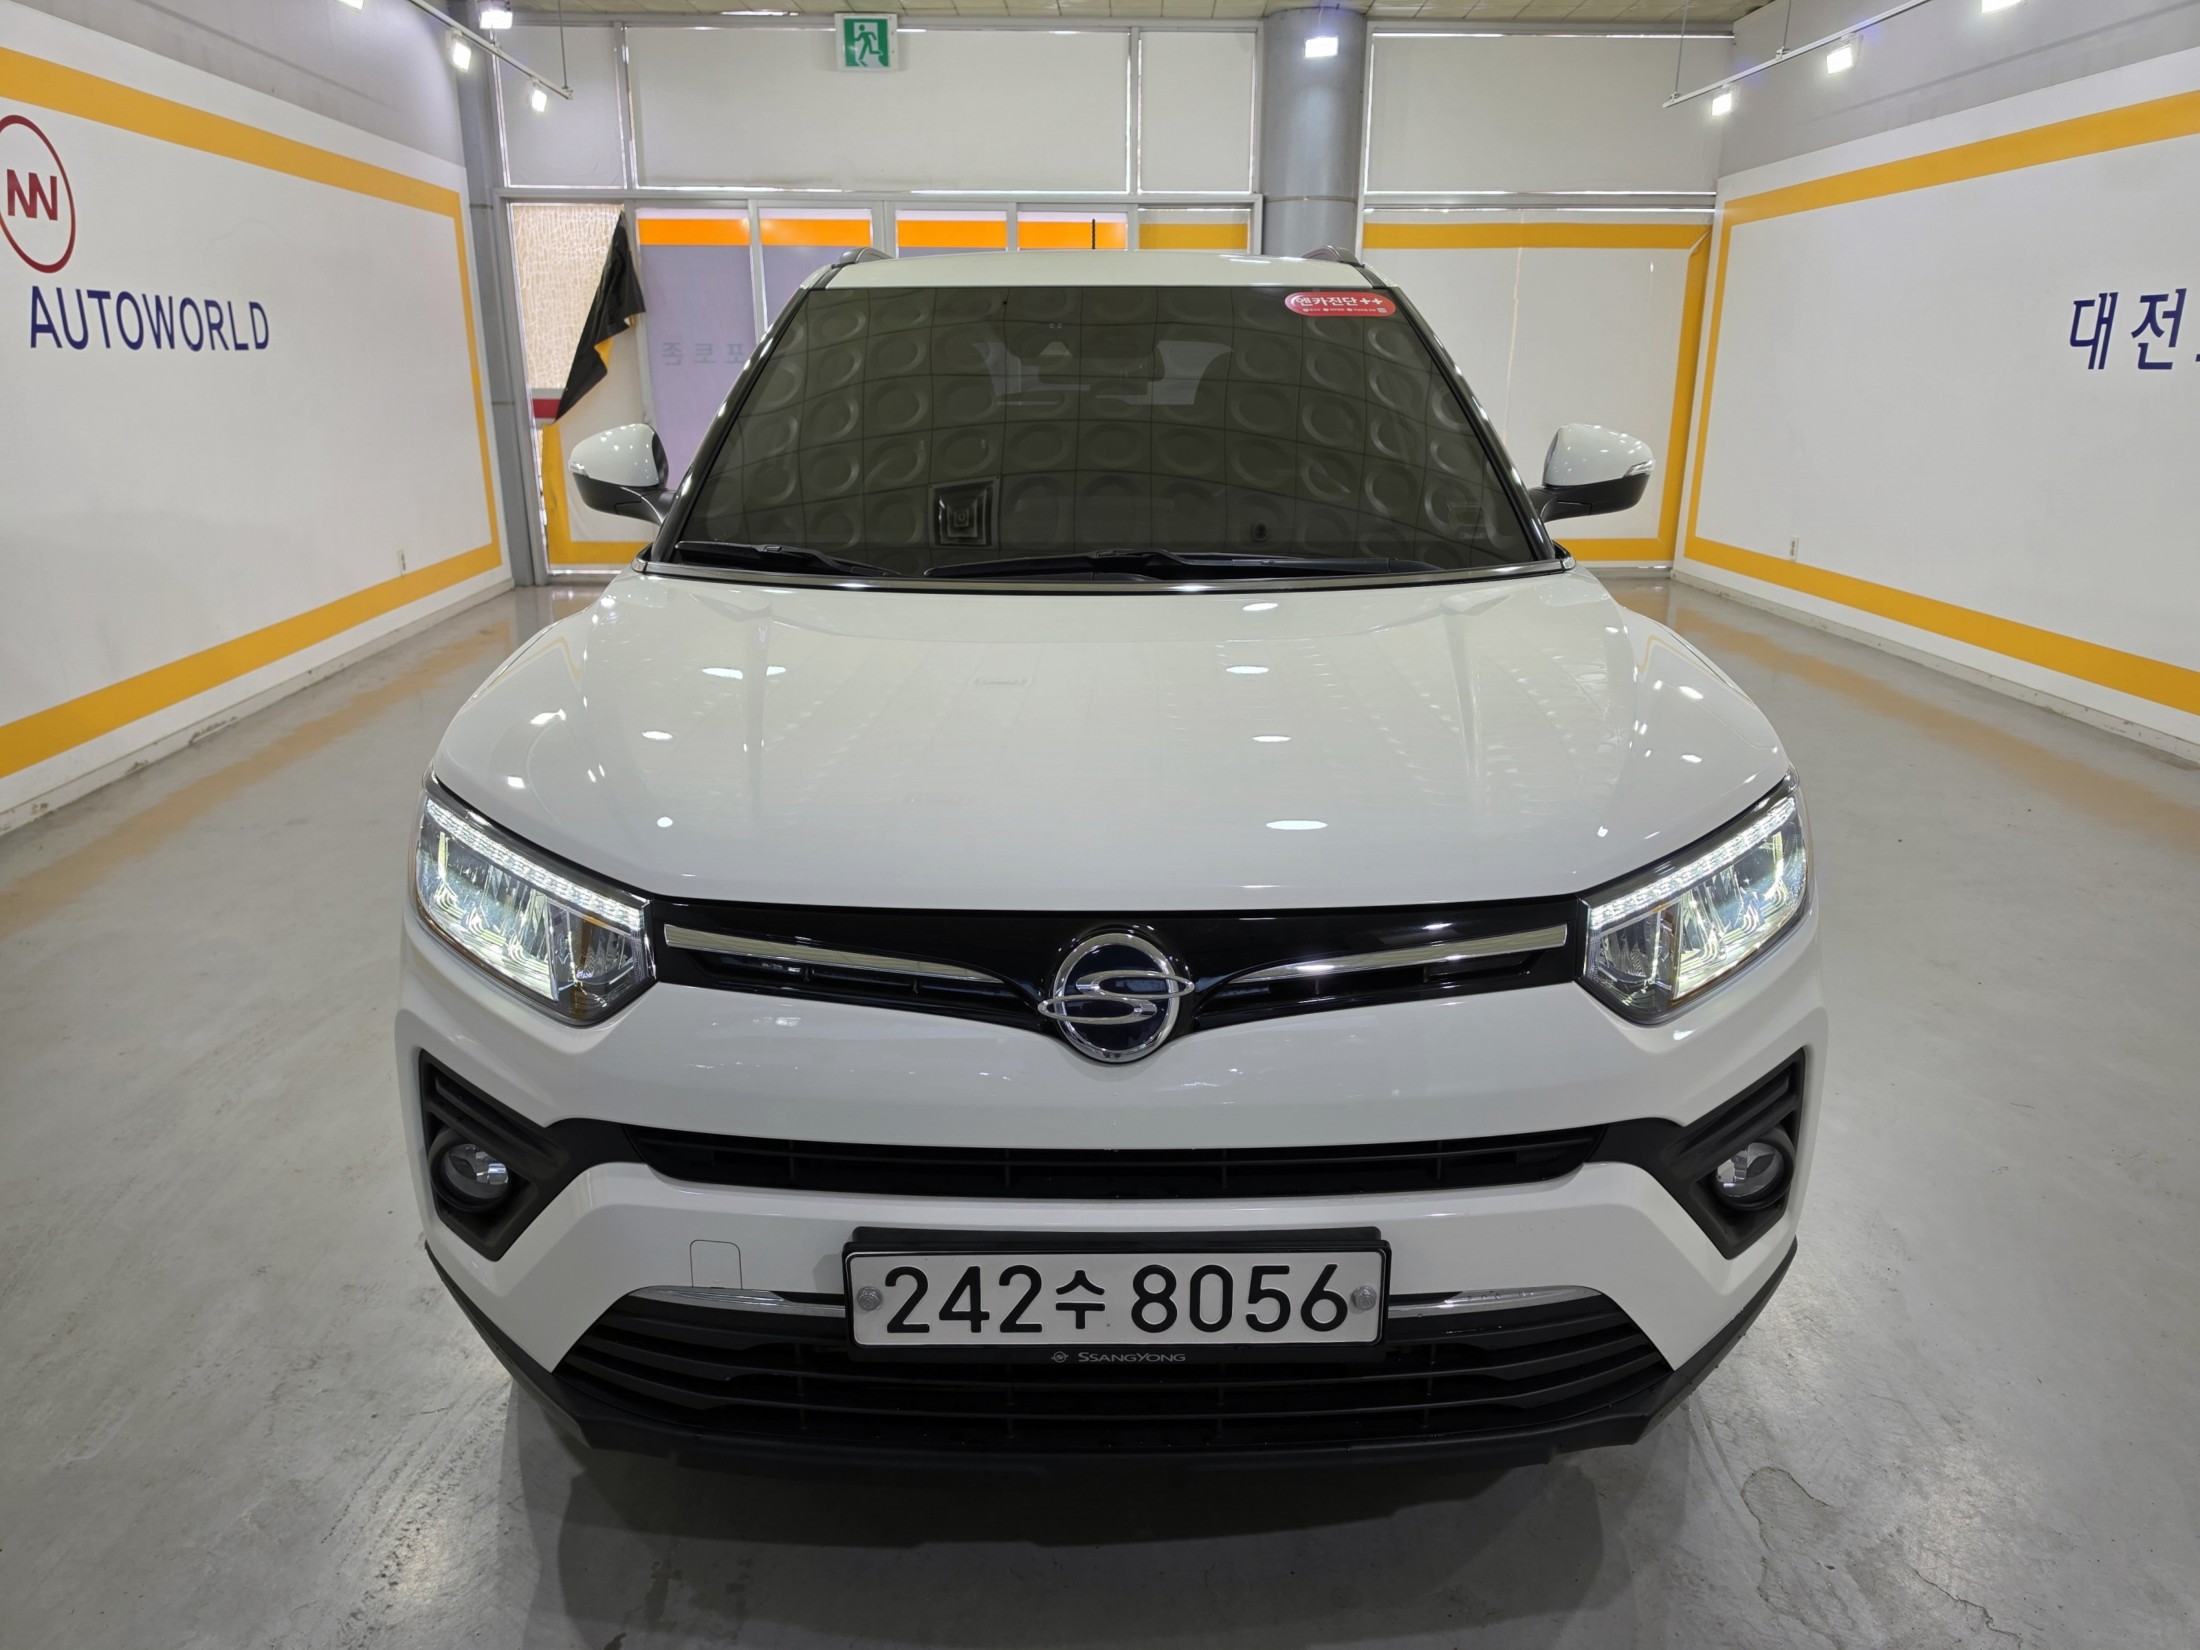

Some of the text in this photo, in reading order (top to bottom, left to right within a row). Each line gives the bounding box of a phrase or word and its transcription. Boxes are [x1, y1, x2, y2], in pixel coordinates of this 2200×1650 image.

[30, 285, 269, 352] AUTOWORLD
[2069, 288, 2200, 370] 대전
[1131, 1263, 1349, 1334] 8056
